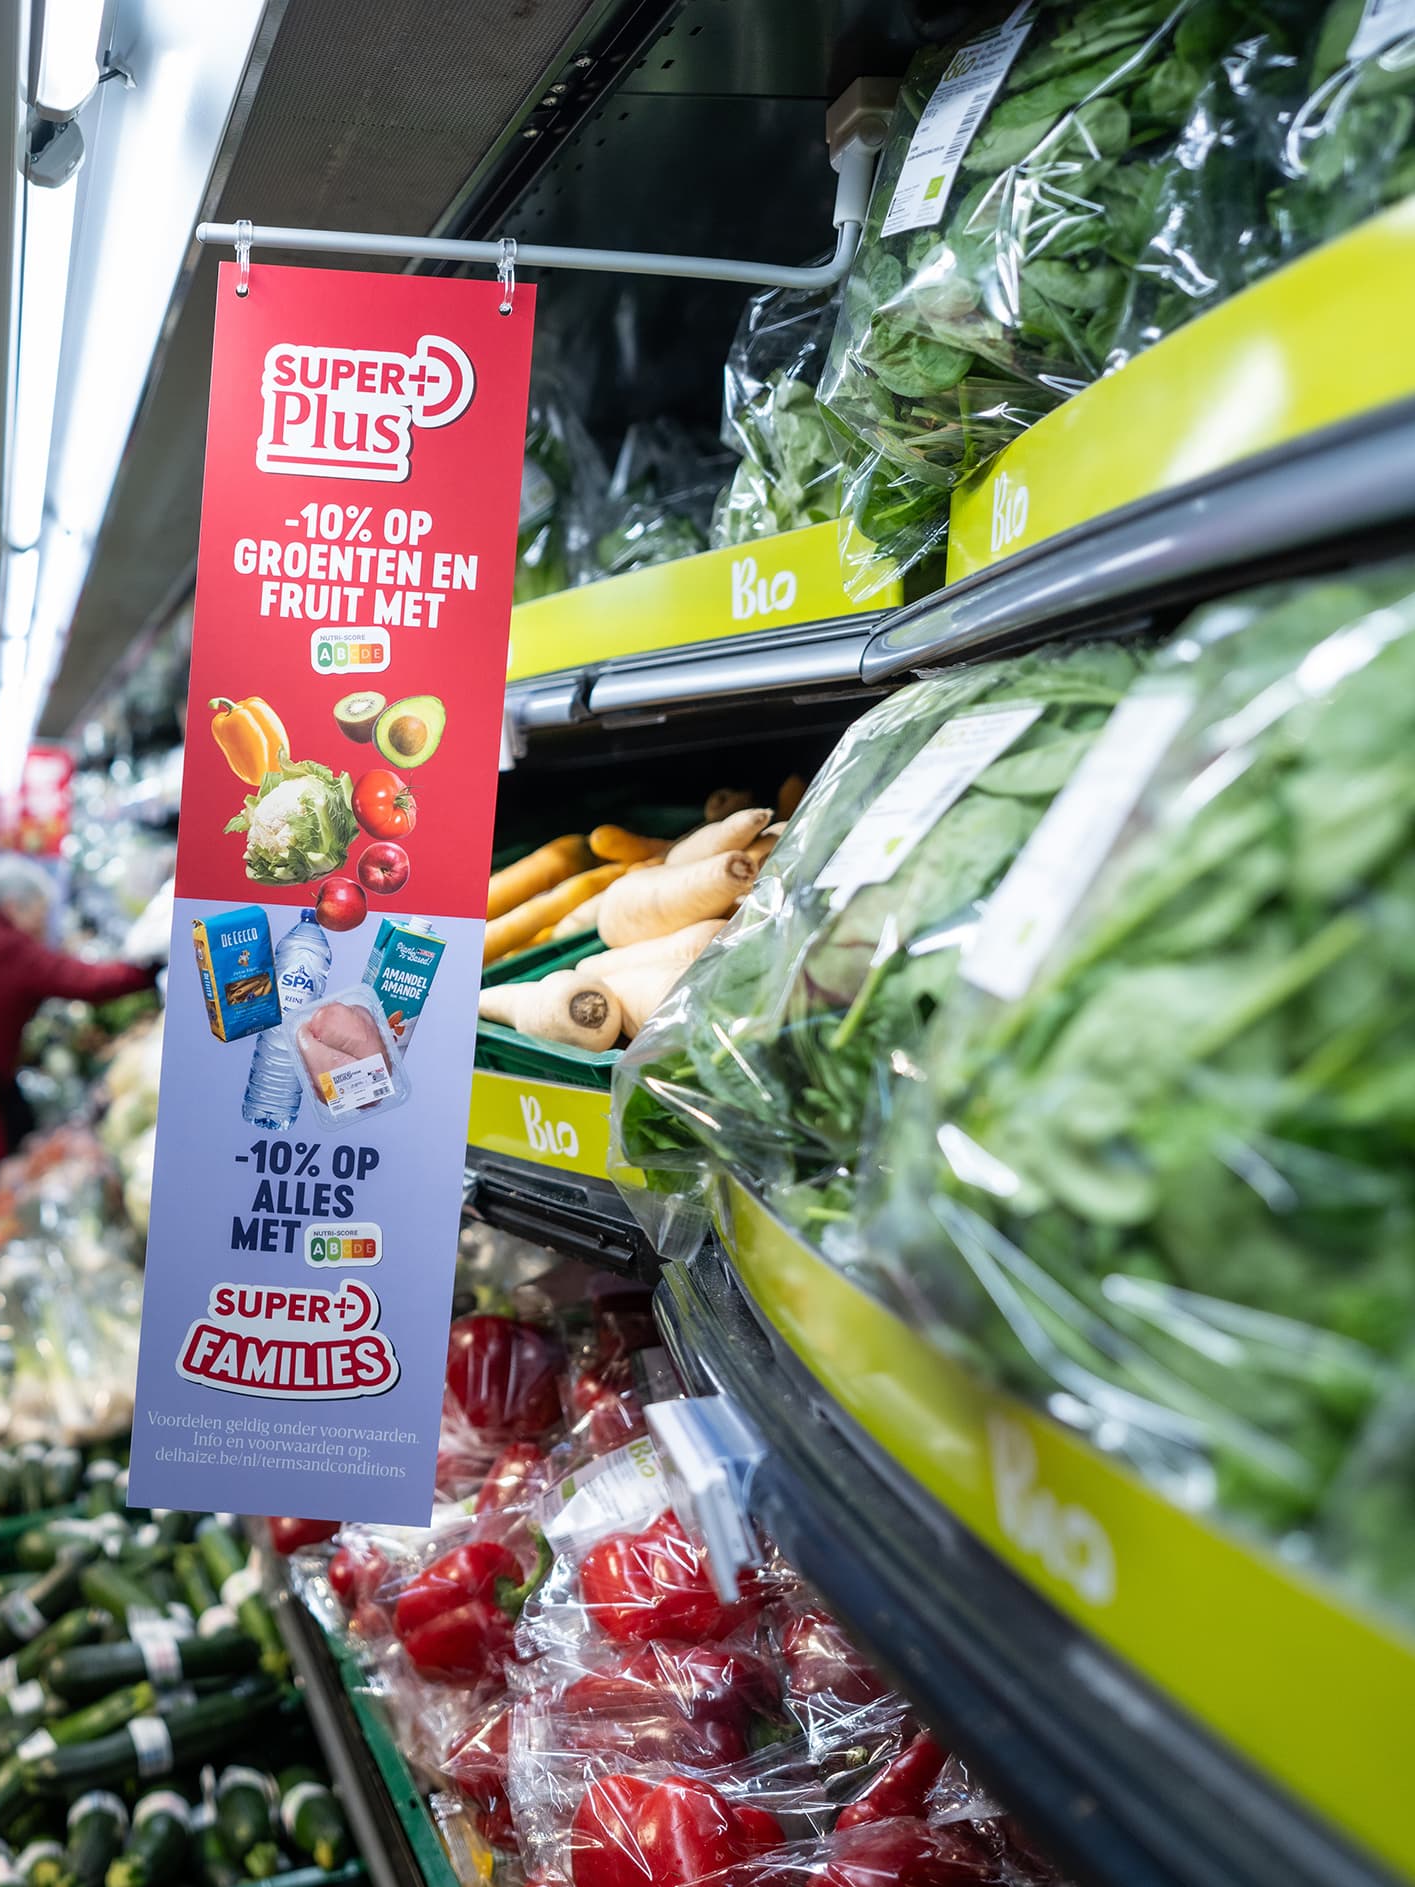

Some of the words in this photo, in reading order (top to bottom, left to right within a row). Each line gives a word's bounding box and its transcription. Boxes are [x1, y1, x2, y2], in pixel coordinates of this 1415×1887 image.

[268, 390, 401, 454] Plus
[285, 503, 373, 543] -10%
[384, 510, 433, 546] OP
[234, 539, 423, 587] GROENTEN
[432, 553, 478, 591] EN
[260, 581, 364, 623] FRUIT
[373, 590, 445, 628] MET
[281, 974, 314, 992] SPA
[380, 980, 423, 1000] AMANDE
[382, 967, 428, 989] AMANDEL
[235, 1140, 321, 1178] -10%
[332, 1145, 379, 1180] OP
[251, 1179, 354, 1219] ALLES
[230, 1217, 301, 1253] MET
[190, 1331, 385, 1386] FAMILIES
[148, 1411, 222, 1430] Voordelen
[225, 1417, 270, 1436] geldig
[273, 1420, 316, 1436] onder
[320, 1426, 420, 1444] voorwaarden.
[193, 1432, 222, 1447] Info
[226, 1437, 244, 1449] en
[248, 1437, 344, 1456] voorwaarden
[348, 1446, 371, 1461] op:
[155, 1447, 406, 1478] delhaize.be/nl/termsandconditions
